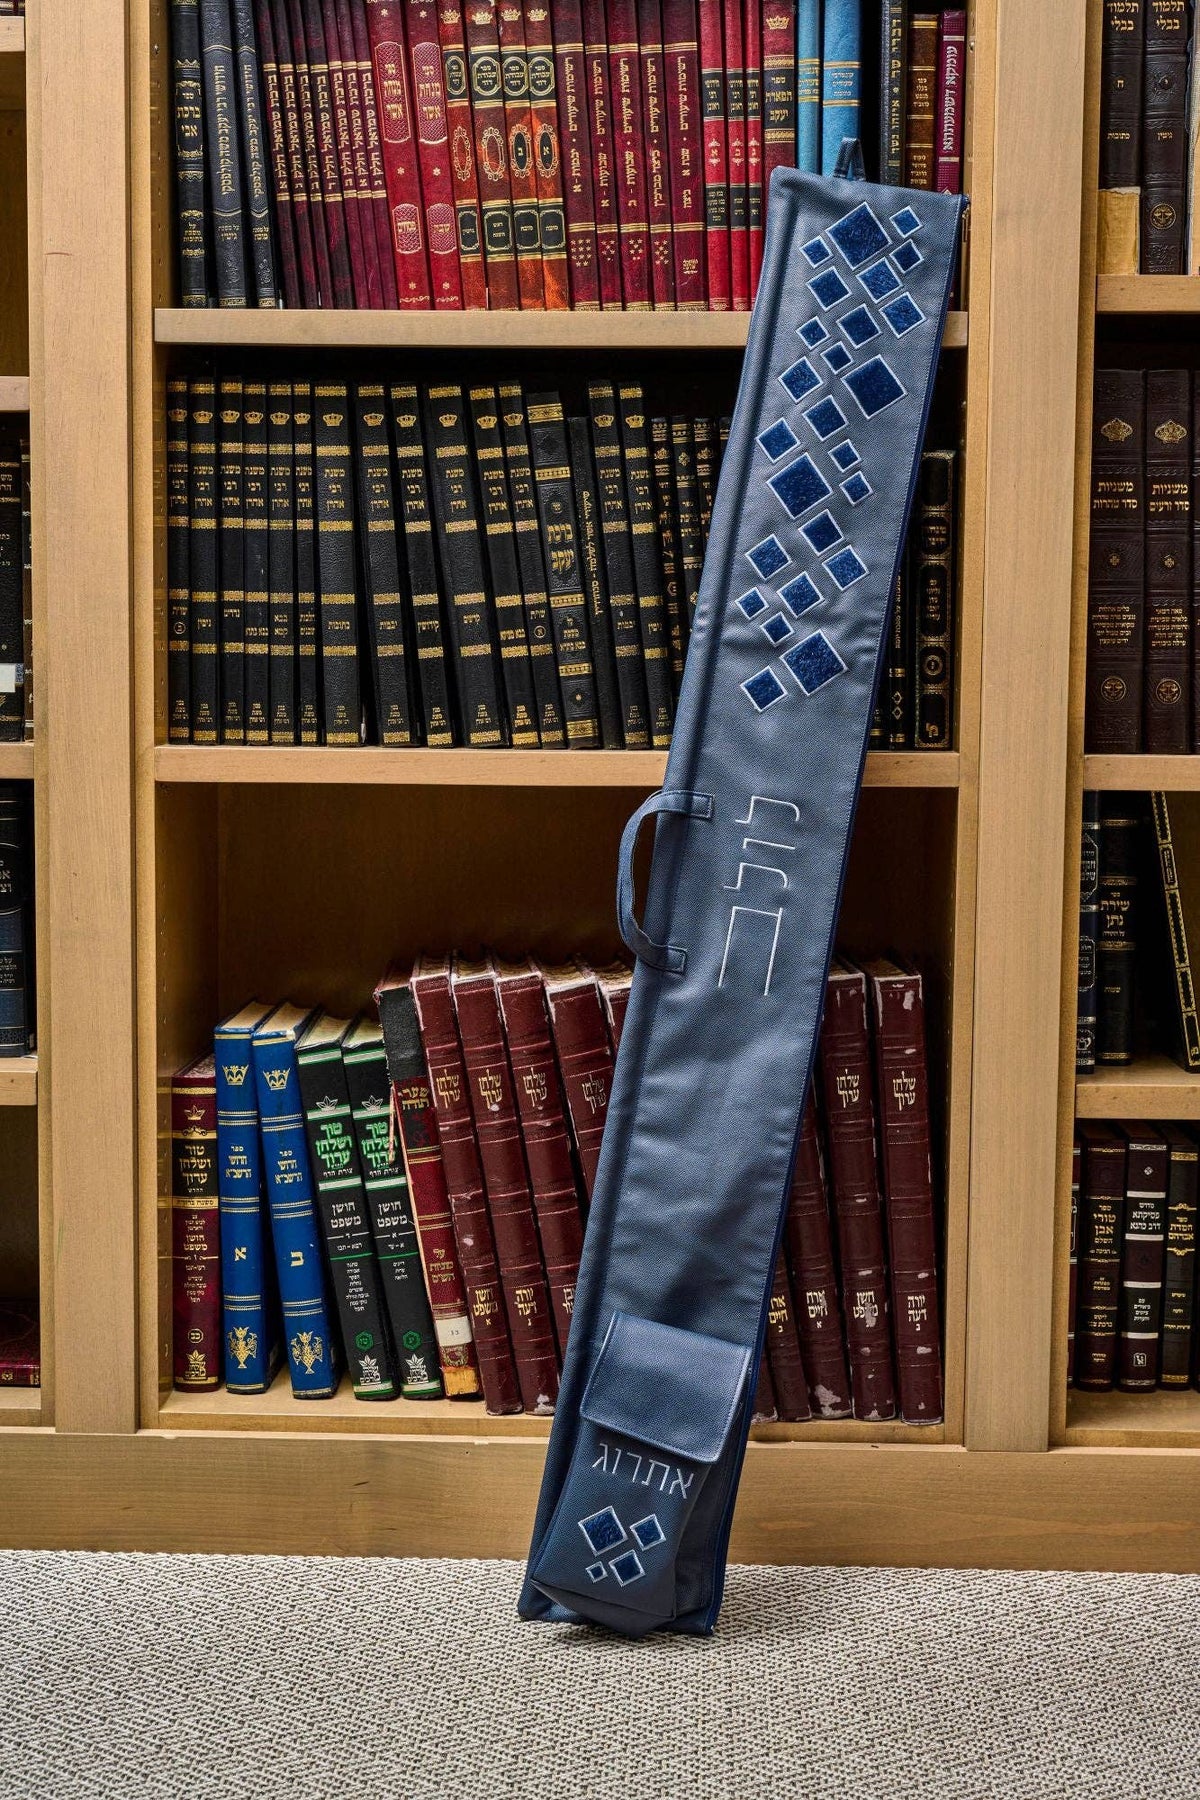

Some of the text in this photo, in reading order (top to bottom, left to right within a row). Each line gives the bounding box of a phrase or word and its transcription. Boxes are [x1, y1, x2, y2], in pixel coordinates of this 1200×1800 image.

[1111, 15, 1134, 31] בבלי
[1156, 15, 1181, 31] בבלי
[177, 106, 202, 119] ברכת
[182, 124, 199, 138] אבי
[234, 1247, 247, 1262] א
[290, 1251, 305, 1267] ב
[592, 1443, 695, 1499] אתרוג
